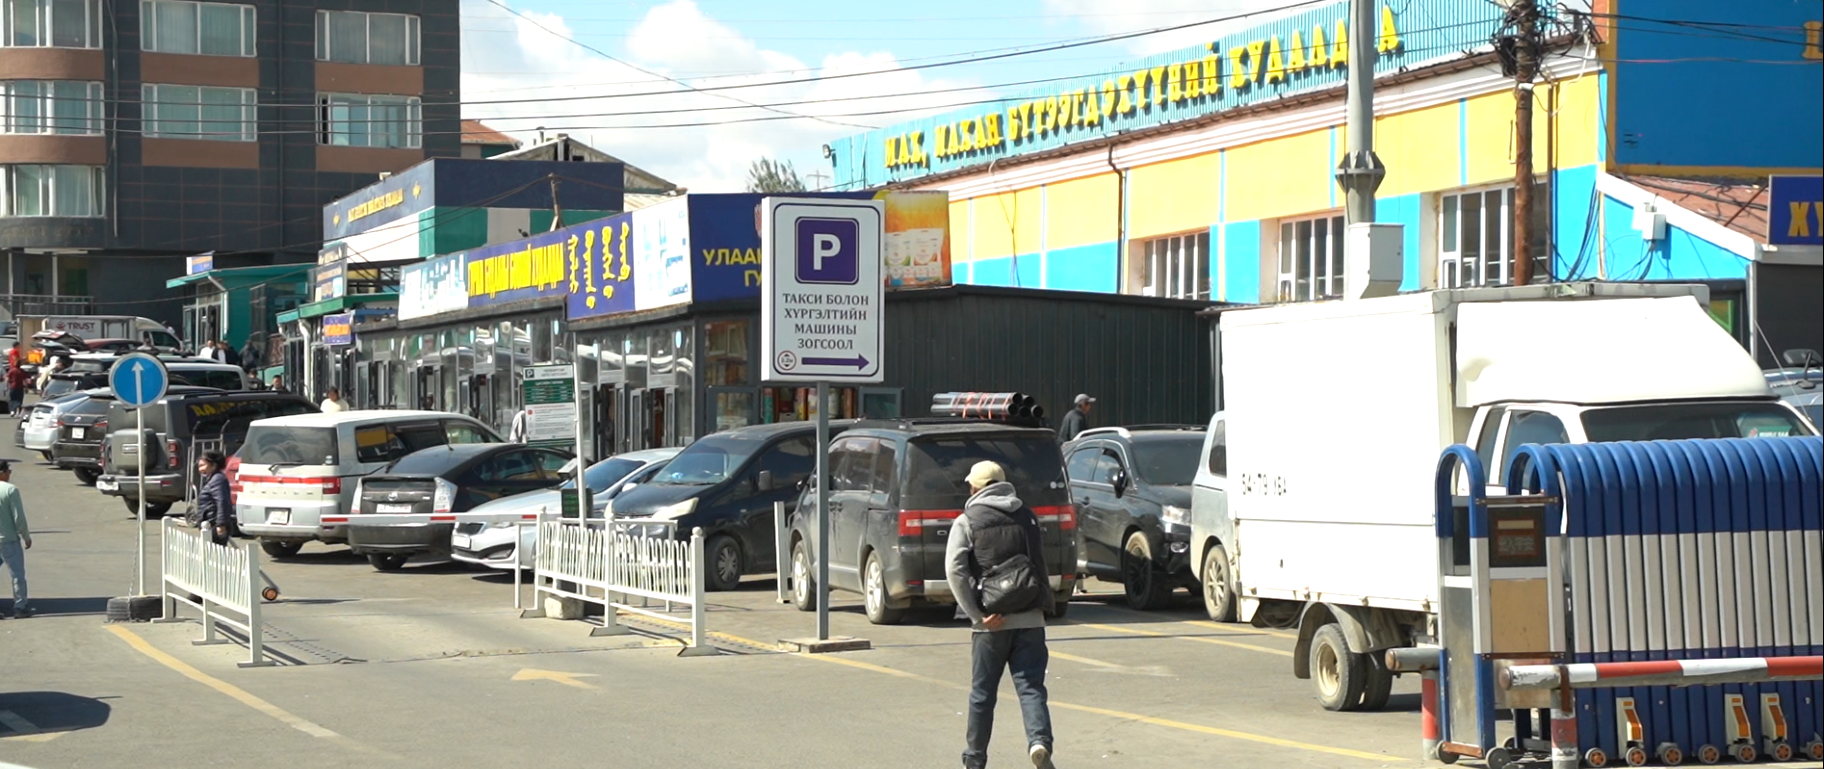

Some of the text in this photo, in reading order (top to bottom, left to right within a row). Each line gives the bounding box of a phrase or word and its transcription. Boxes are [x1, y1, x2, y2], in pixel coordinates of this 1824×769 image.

[885, 131, 927, 168] МАХ,
[934, 113, 1001, 158] МАХАН
[1228, 5, 1400, 88] ХУДАЛДА
[813, 234, 841, 270] P
[782, 293, 869, 305] ТАКСИ БОЛОН
[784, 308, 867, 320] ХҮРГЭЛТИЙН
[67, 321, 96, 330] TRUST
[794, 323, 857, 335] МАШИНЫ
[797, 338, 853, 350] ЗОГСООЛ
